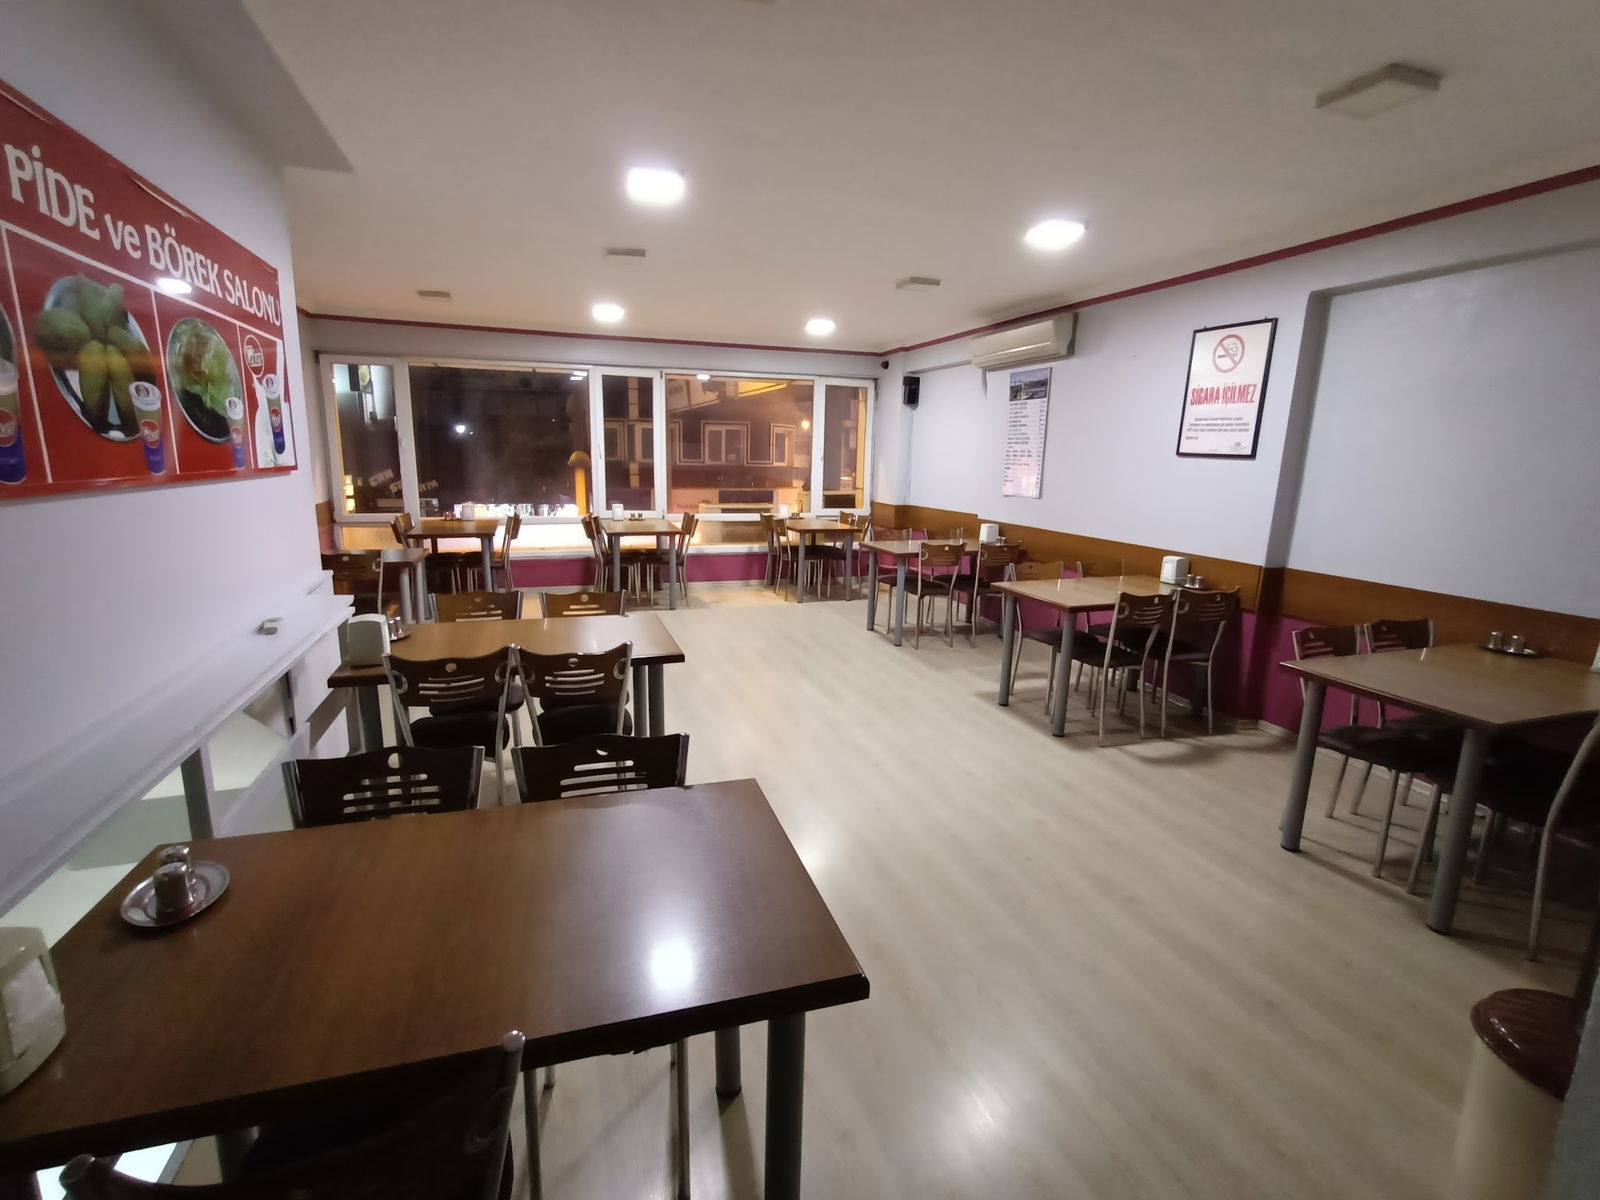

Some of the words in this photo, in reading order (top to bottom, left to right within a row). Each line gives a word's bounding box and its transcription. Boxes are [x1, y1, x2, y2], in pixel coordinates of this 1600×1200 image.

[4, 144, 101, 240] PİDE
[104, 213, 142, 260] ve
[144, 222, 224, 299] BÖREK
[223, 269, 281, 326] SALONU
[1190, 384, 1220, 406] SİGARA
[1221, 381, 1257, 407] İÇİLMEZ
